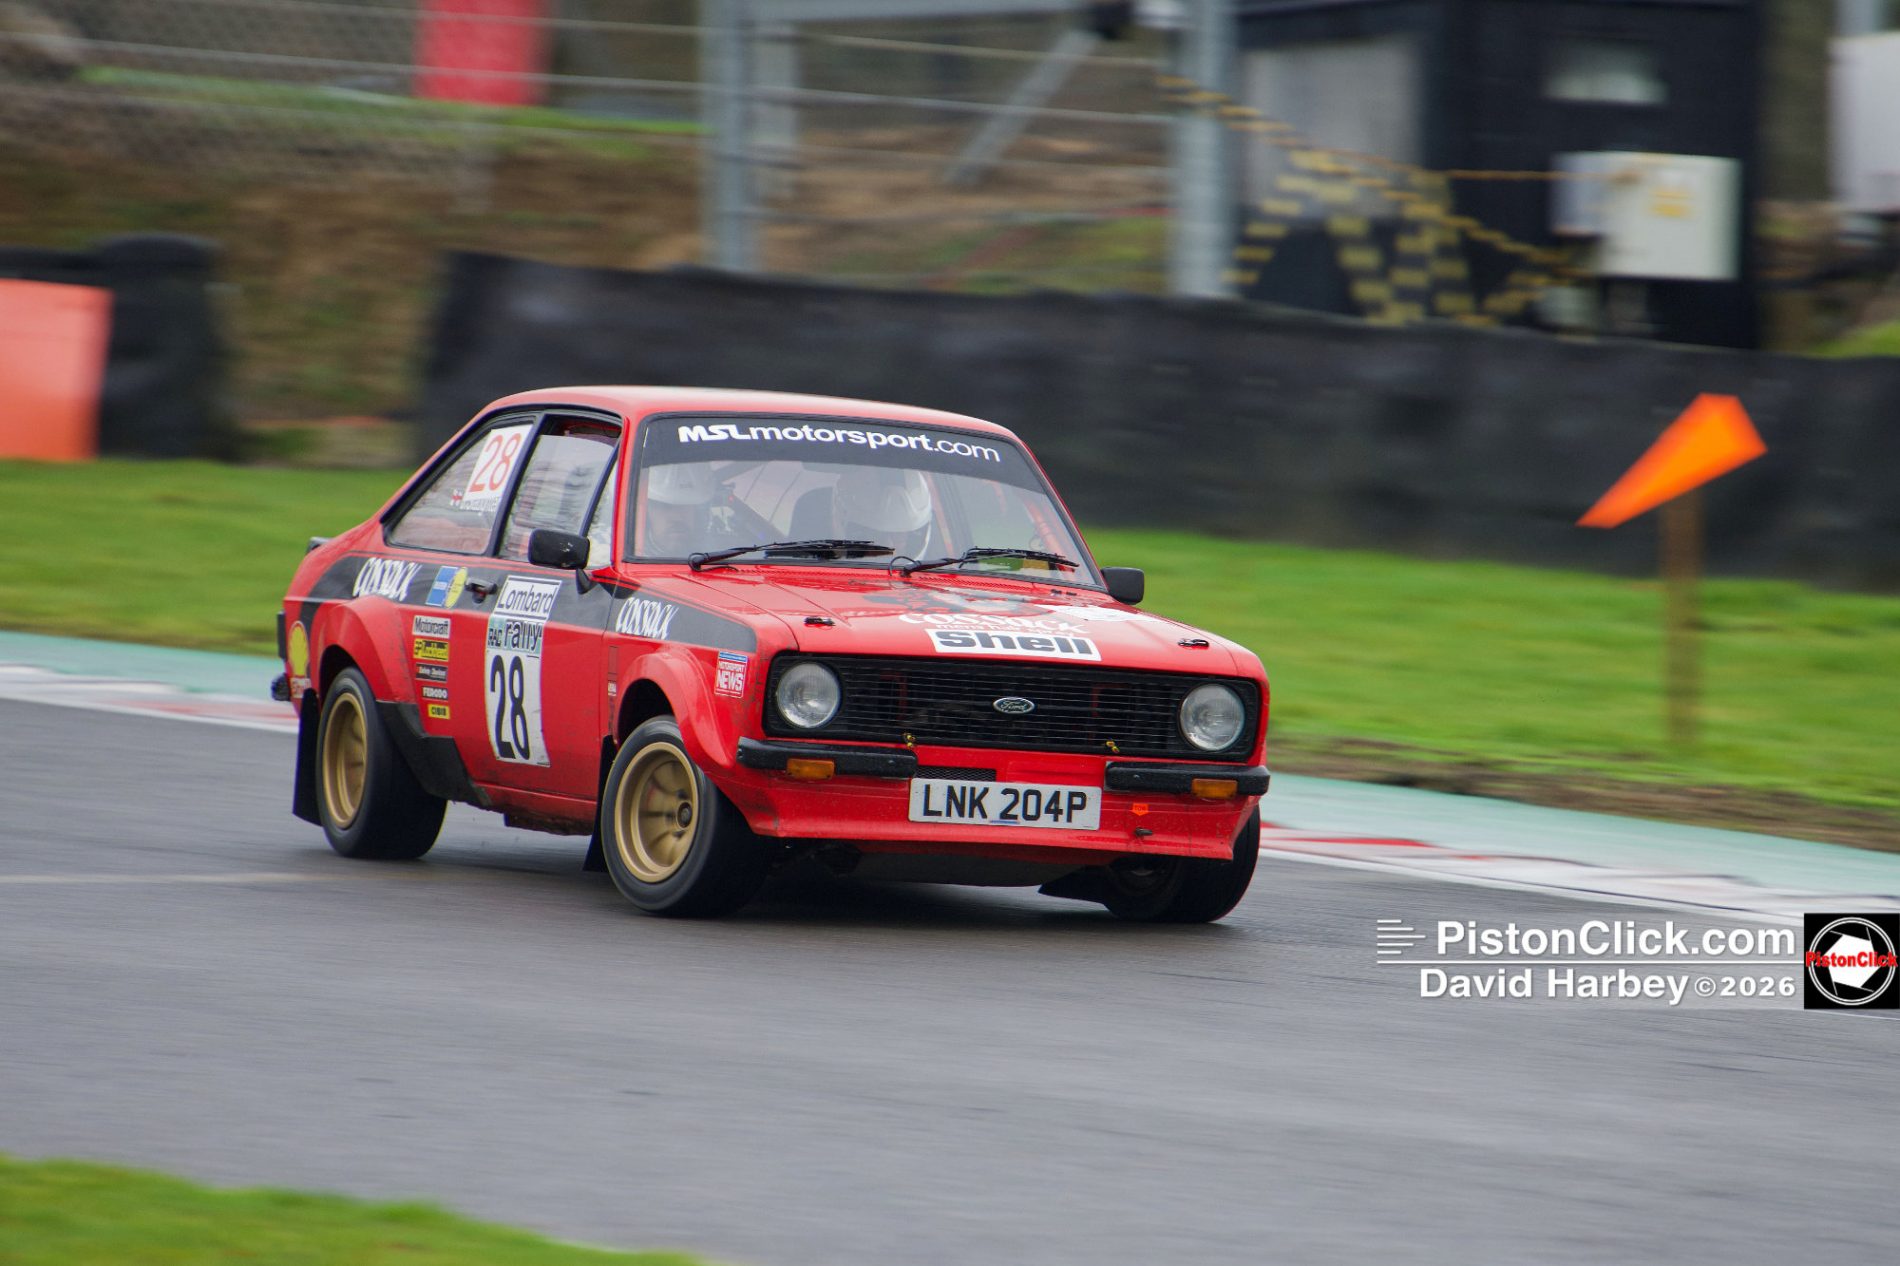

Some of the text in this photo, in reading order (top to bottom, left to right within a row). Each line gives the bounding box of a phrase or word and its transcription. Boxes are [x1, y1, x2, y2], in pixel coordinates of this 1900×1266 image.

[678, 424, 1001, 462] MSLmotorsport.com
[469, 433, 521, 492] 28
[498, 584, 557, 615] Lombard
[415, 617, 449, 635] Motorcraft
[488, 620, 542, 651] RAC rally
[422, 686, 448, 699] FERODO
[716, 670, 744, 691] NEWS
[490, 654, 530, 760] 28
[1000, 701, 1030, 711] Ford
[923, 784, 1087, 823] LNK 204P
